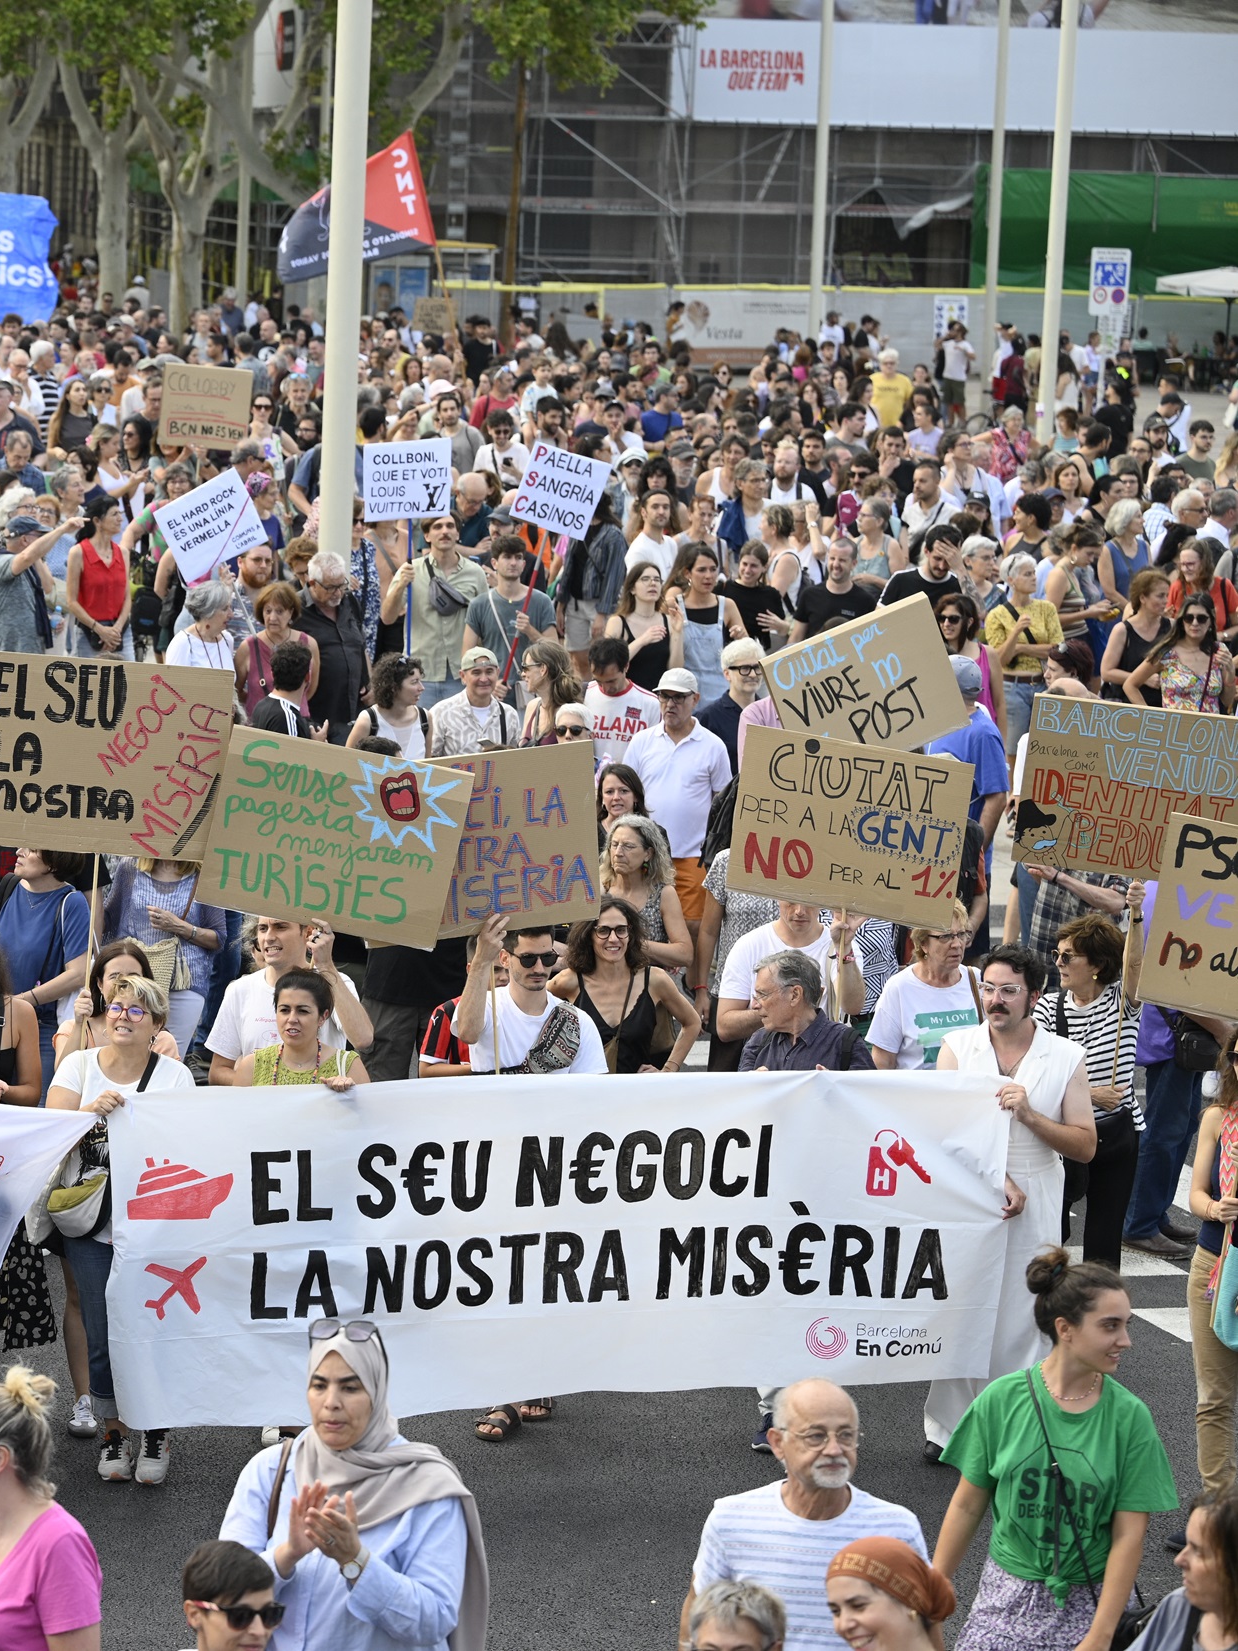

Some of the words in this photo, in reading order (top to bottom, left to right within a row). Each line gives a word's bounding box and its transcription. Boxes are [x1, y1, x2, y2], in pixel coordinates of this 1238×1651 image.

[700, 49, 717, 68] LA
[720, 49, 804, 70] BARCELONA
[728, 71, 755, 91] QUE
[757, 72, 790, 91] FEM
[706, 326, 743, 340] Vesta
[169, 421, 197, 436] BCN
[202, 425, 214, 435] NO
[215, 426, 226, 438] ES
[372, 470, 398, 482] QUE
[402, 469, 417, 481] ET
[420, 467, 448, 479] VOTI
[373, 452, 439, 466] COLLBONI,
[534, 446, 593, 478] PAELLA
[166, 518, 181, 530] EL
[181, 502, 209, 522] HARD
[209, 486, 237, 507] ROCK
[371, 486, 406, 497] LOUIS
[173, 528, 188, 541] ÉS
[188, 518, 210, 533] UNA
[210, 503, 235, 522] LÍNIA
[179, 520, 232, 553] VERMELLA
[231, 526, 256, 543] COMUNS
[850, 621, 889, 662] per
[43, 660, 128, 730] SEU
[848, 676, 925, 744] POST
[1028, 739, 1079, 758] Barcelona
[1084, 751, 1100, 760] en
[1036, 697, 1238, 762] BARCELON
[236, 739, 350, 808] Sense
[224, 794, 361, 837] pagesia
[522, 784, 569, 829] LA
[1031, 768, 1235, 825] IDENTITAT
[739, 794, 789, 825] PER
[799, 806, 816, 832] A
[828, 811, 852, 838] LA
[856, 811, 954, 858] GENT
[1066, 811, 1164, 873] PERDU
[275, 832, 434, 880] menjarem
[458, 831, 532, 874] TRA
[743, 831, 814, 881] NO
[829, 863, 863, 885] PER
[911, 866, 957, 900] 1%
[1174, 823, 1238, 880] PS
[442, 854, 596, 925] ISERIA
[1158, 931, 1203, 970] no
[930, 1016, 944, 1025] My
[250, 1149, 333, 1226] EL
[250, 1250, 340, 1320] LA
[362, 1230, 630, 1315] NOSTRA
[855, 1322, 928, 1338] Barcelona
[855, 1339, 882, 1357] En
[885, 1336, 943, 1358] Comú
[1018, 1467, 1098, 1513] STOP
